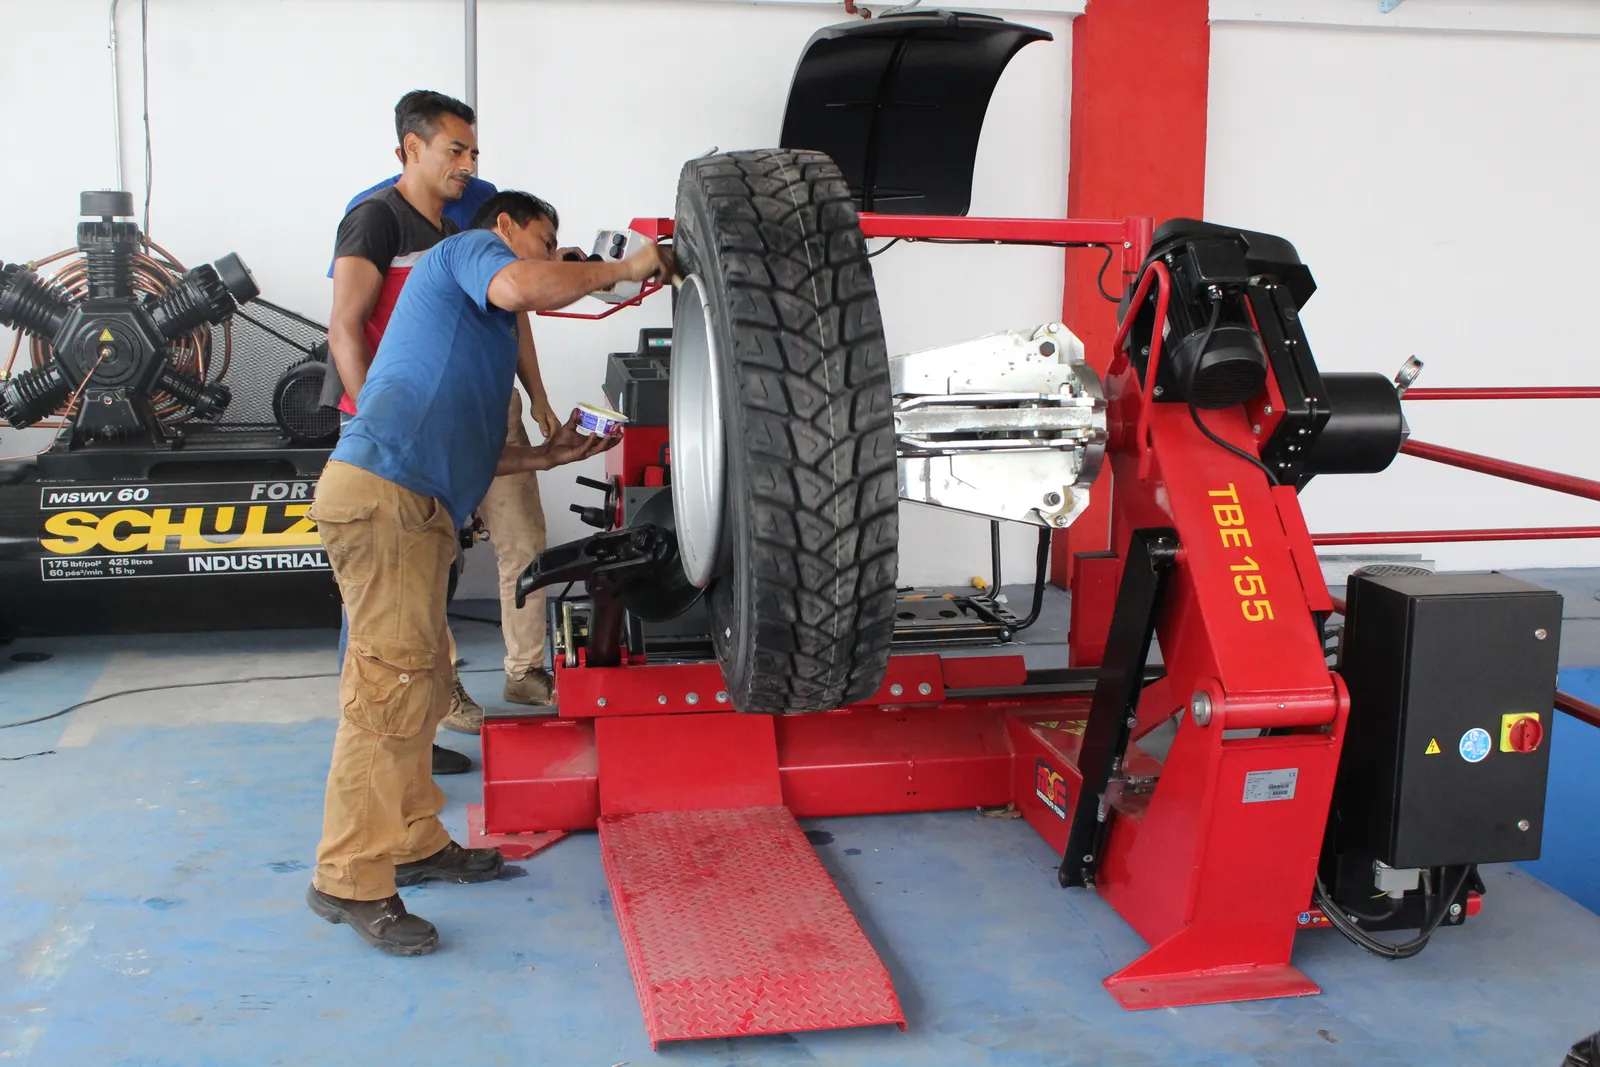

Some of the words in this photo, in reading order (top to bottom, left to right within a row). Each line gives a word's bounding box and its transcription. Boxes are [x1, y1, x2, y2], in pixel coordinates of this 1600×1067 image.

[48, 491, 113, 504] MSWV
[117, 488, 149, 502] 60
[40, 504, 322, 554] SCHULZ
[1208, 483, 1252, 547] TBE
[1230, 556, 1274, 621] 155
[108, 558, 129, 566] 425
[188, 552, 329, 572] INDUSTRIAL
[49, 569, 64, 577] 60
[108, 567, 122, 575] 15
[123, 567, 136, 575] hp
